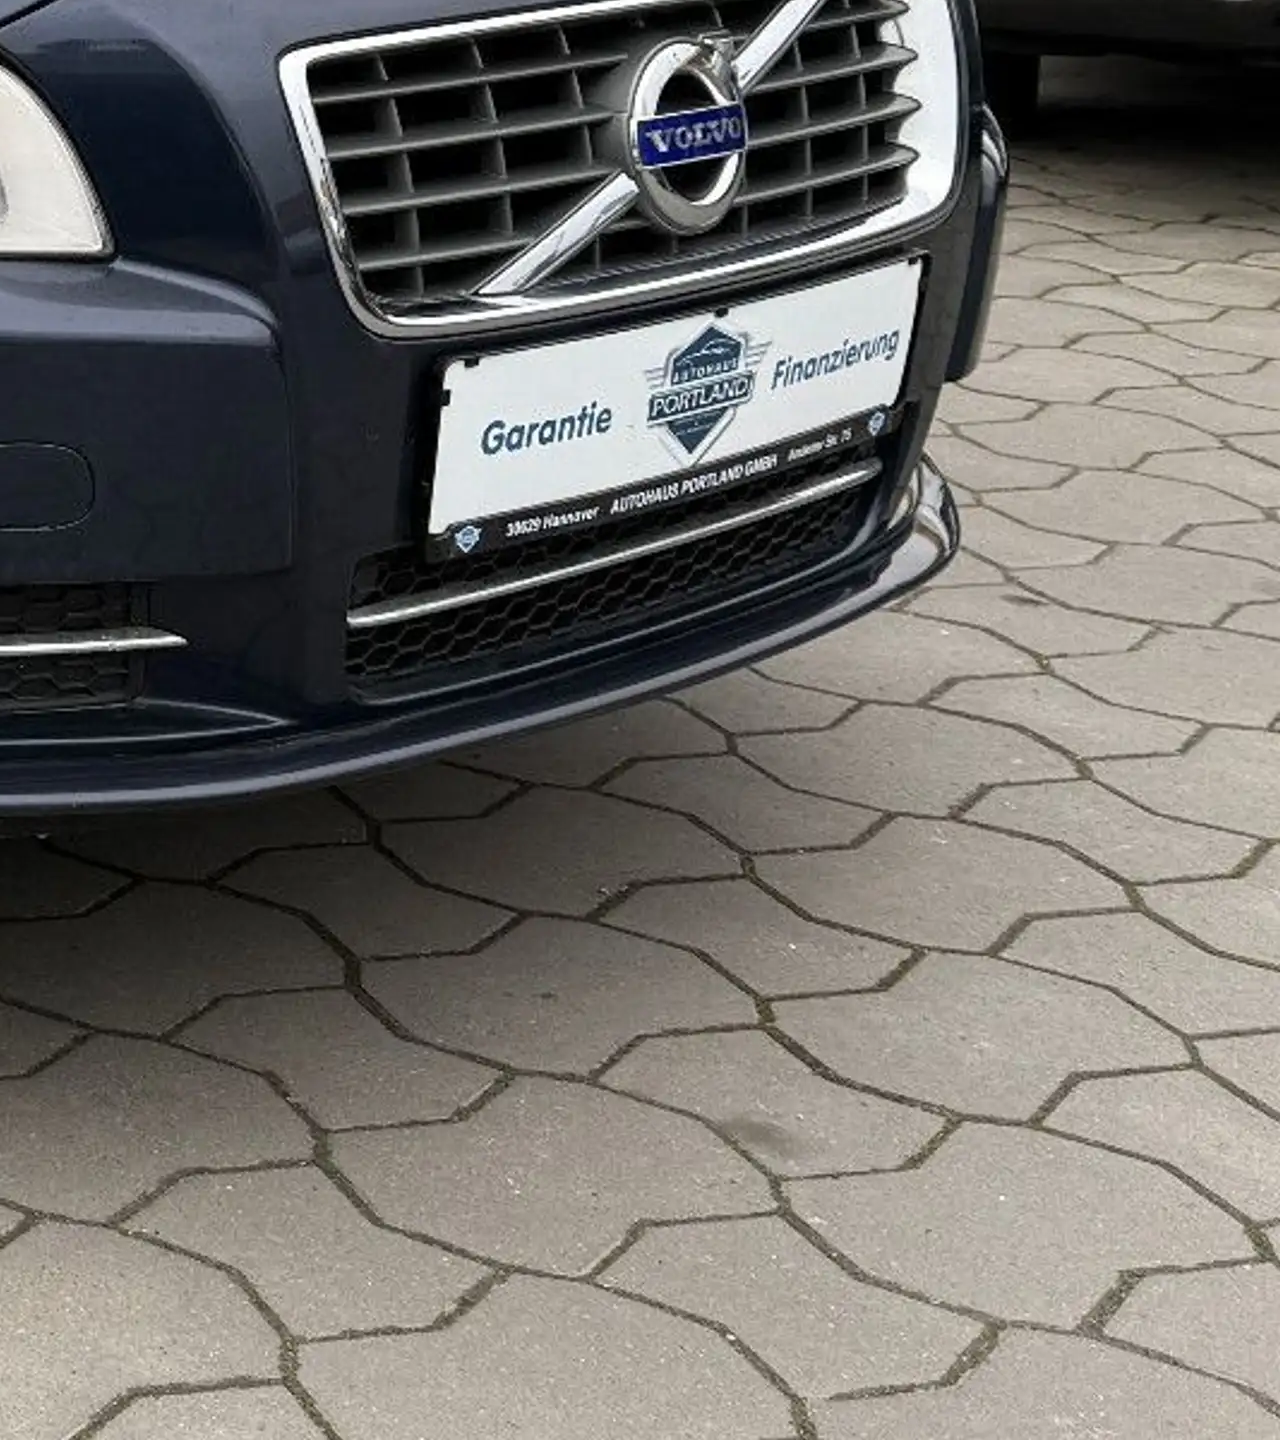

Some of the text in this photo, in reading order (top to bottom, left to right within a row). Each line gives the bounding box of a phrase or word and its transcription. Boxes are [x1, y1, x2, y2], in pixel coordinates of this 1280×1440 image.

[644, 116, 742, 153] VOLVO
[672, 358, 738, 383] AUTOHAUS
[771, 329, 900, 391] Finanzierung
[651, 376, 749, 417] PORTLAND
[481, 400, 612, 455] Garantie
[542, 506, 601, 529] Hannover
[610, 481, 679, 515] AUTOHAUS
[680, 464, 743, 494] PORTLAND
[744, 453, 777, 476] GMBH
